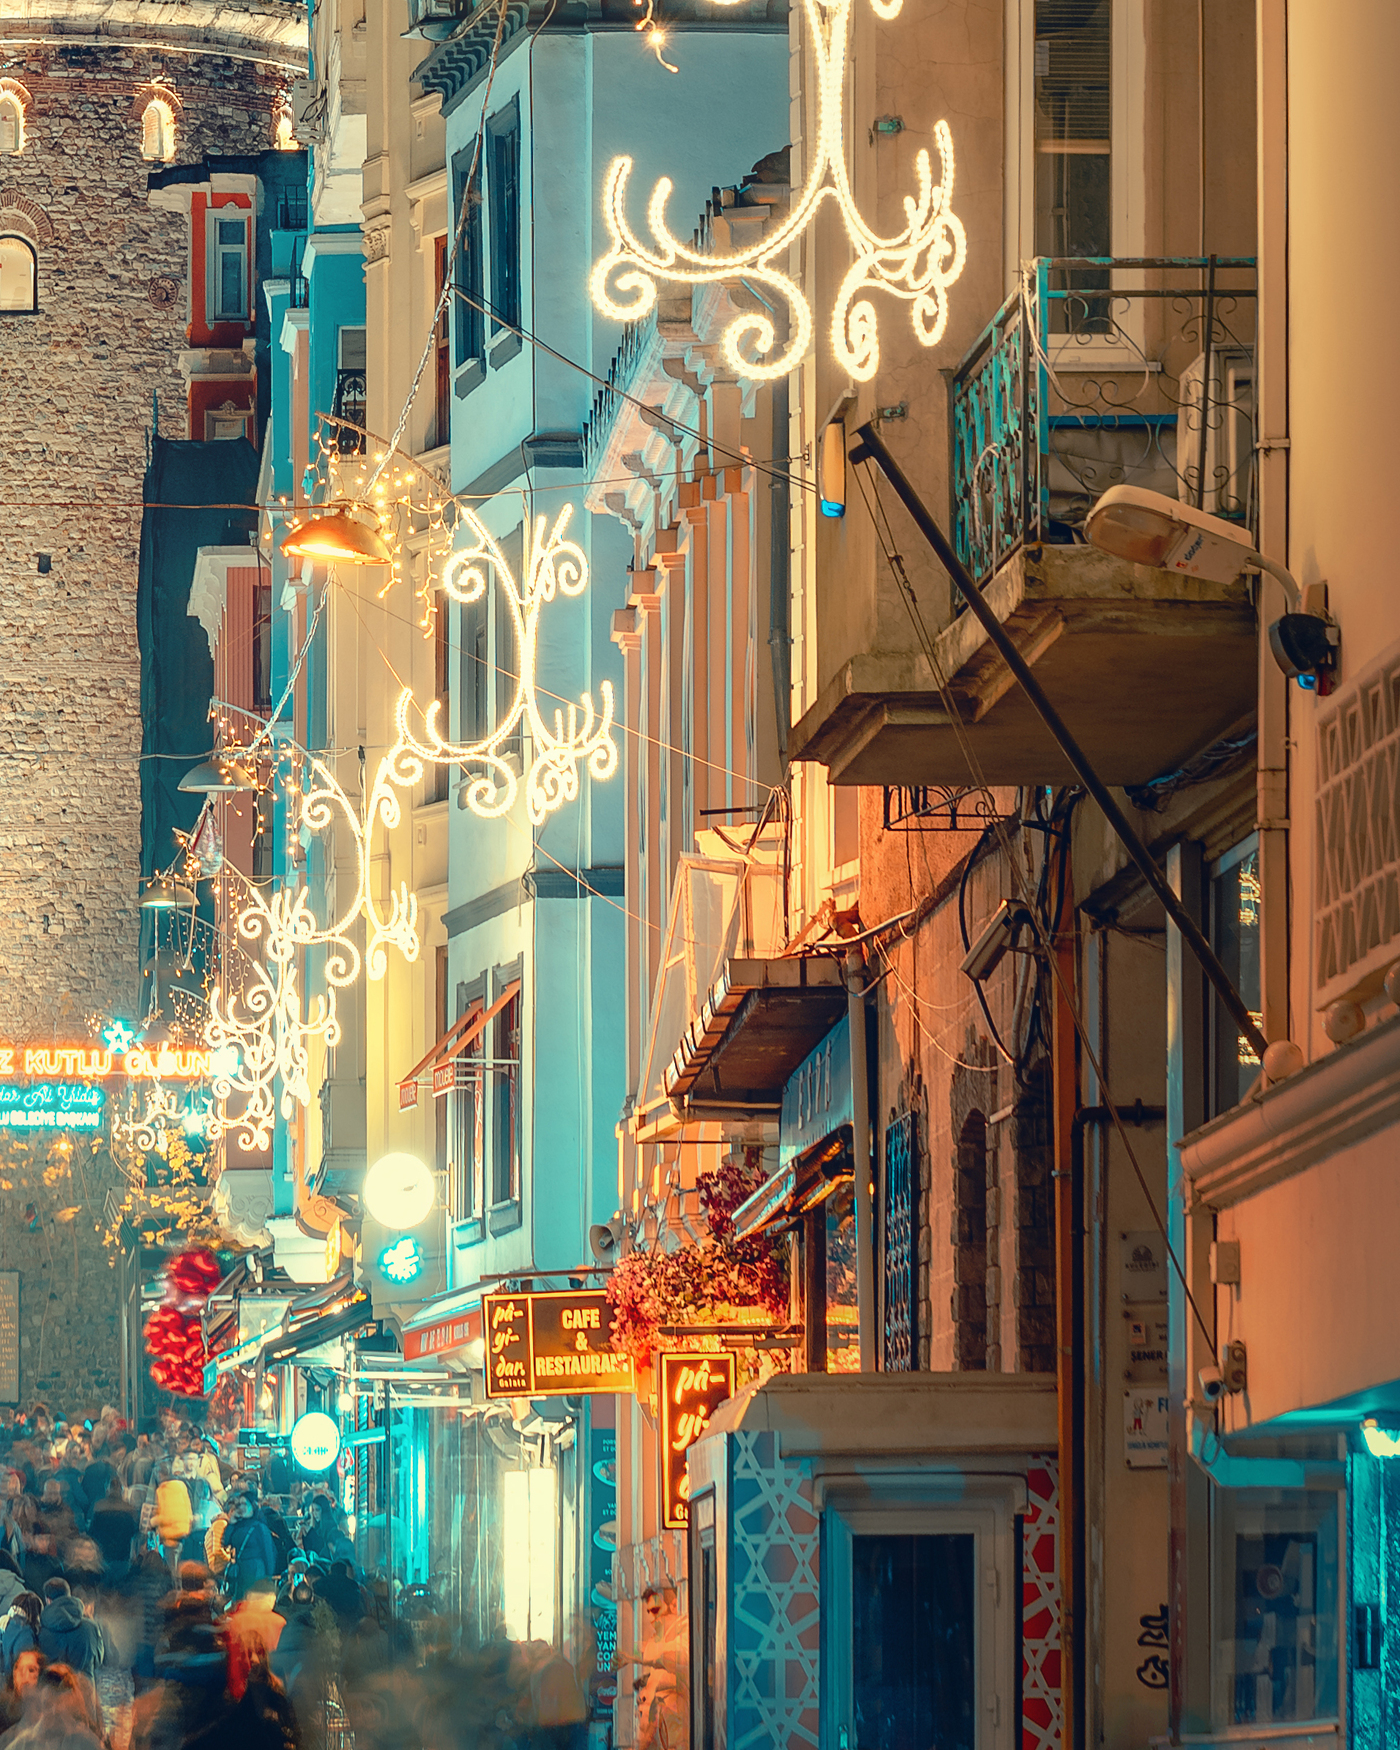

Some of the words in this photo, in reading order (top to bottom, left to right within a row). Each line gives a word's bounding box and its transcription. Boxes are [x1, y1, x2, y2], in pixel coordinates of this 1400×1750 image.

[25, 1049, 112, 1075] KUTLU
[23, 1085, 54, 1107] Ali
[561, 1307, 601, 1330] CAFE
[575, 1331, 589, 1351] &
